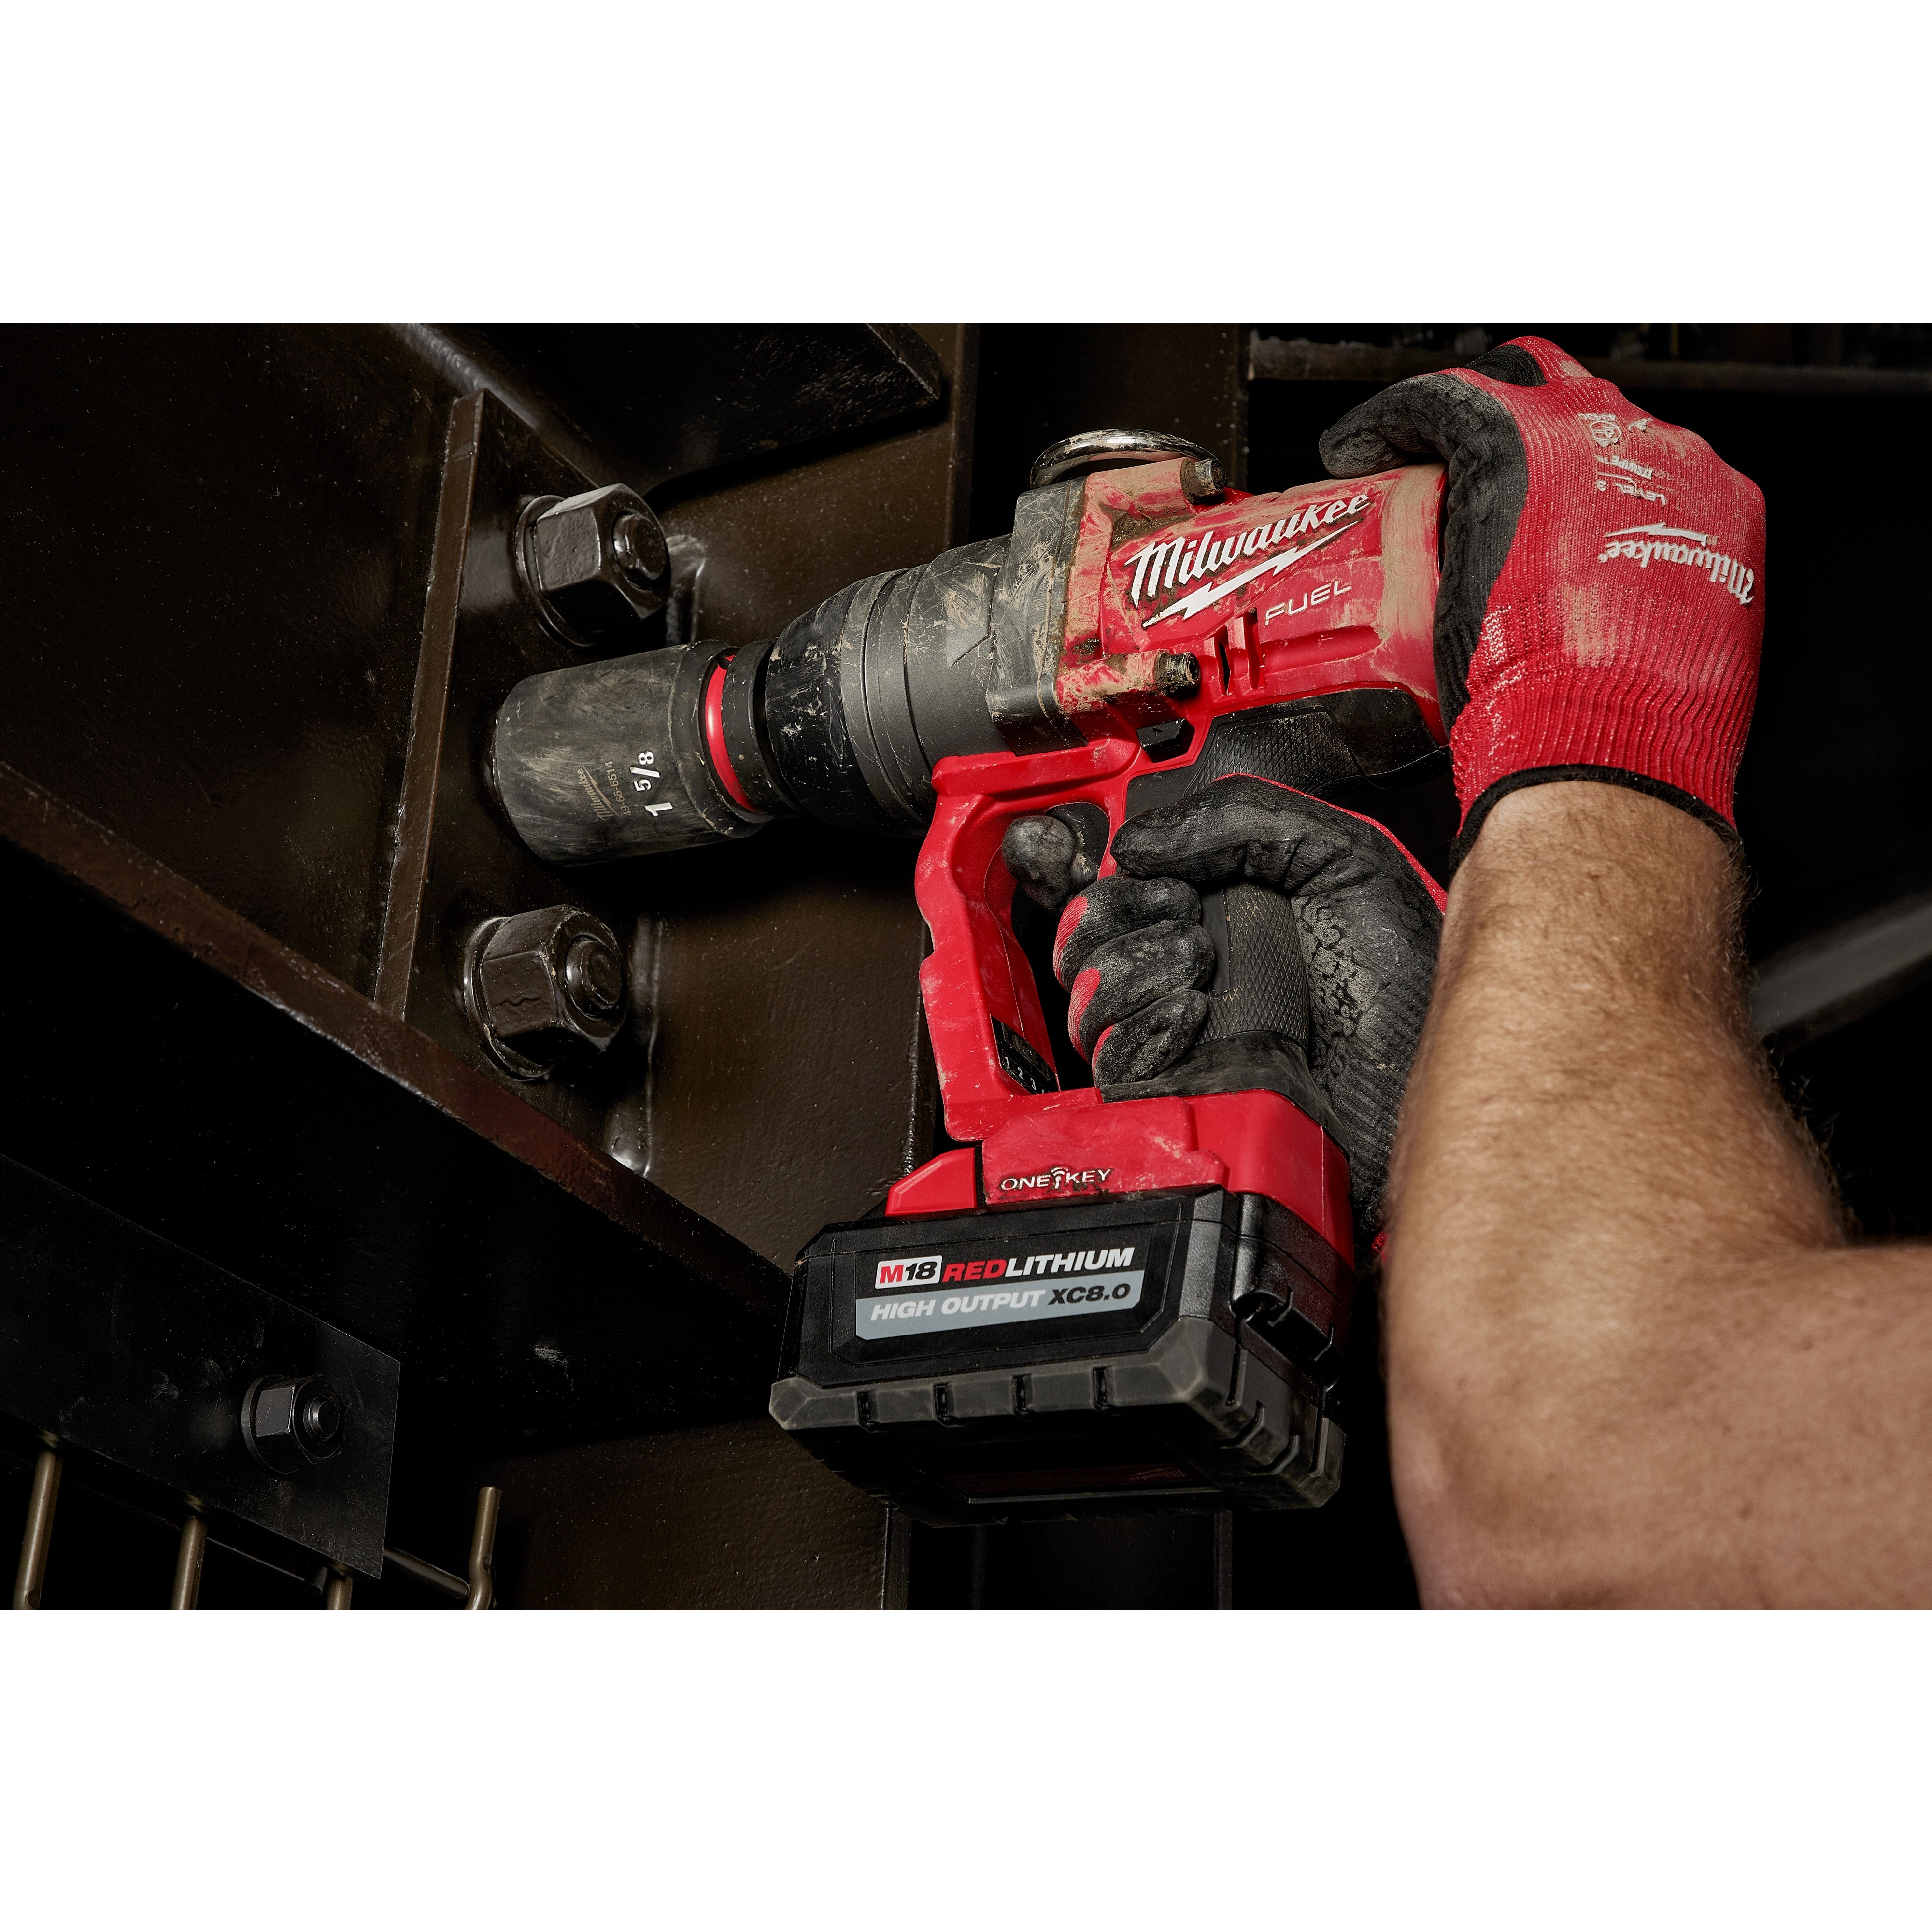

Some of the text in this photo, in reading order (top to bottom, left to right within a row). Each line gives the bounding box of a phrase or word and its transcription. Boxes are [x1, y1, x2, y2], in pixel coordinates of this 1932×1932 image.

[1124, 494, 1372, 609] Milwaukee
[1264, 580, 1352, 626] FUEL
[605, 761, 632, 816] 49-66-6514
[630, 751, 661, 791] 5/8
[577, 767, 613, 821] Milwaukee
[1017, 1067, 1024, 1080] 2
[1030, 1078, 1037, 1091] 3
[879, 1261, 938, 1284] M18
[870, 1283, 1131, 1321] HIGH OUTPUT XC8.0
